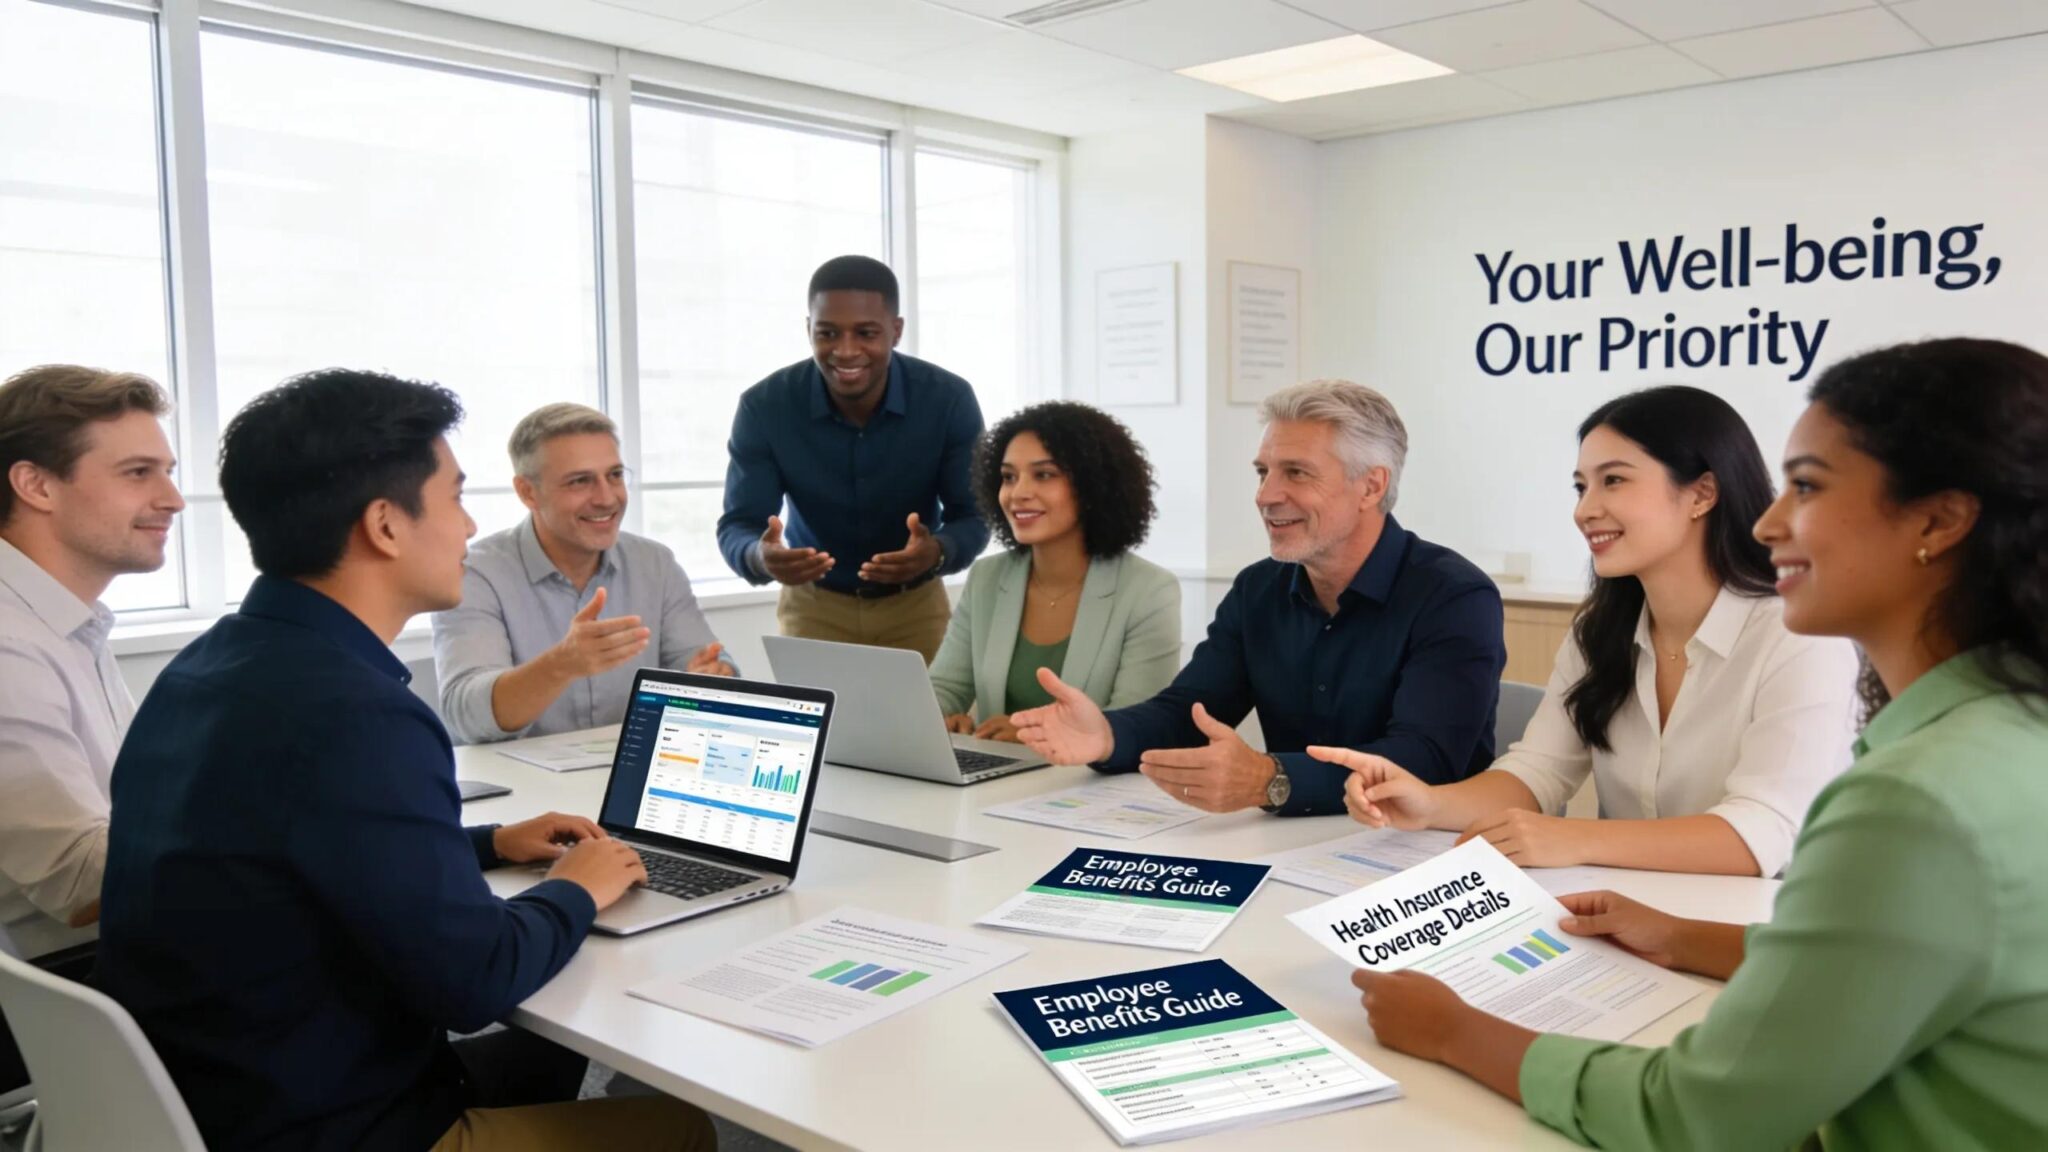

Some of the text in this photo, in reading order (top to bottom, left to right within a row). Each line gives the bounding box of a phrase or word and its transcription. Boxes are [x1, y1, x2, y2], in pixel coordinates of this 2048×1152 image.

[1474, 216, 2002, 305] Your Well-being,
[1475, 307, 1830, 382] Our Priority
[1062, 869, 1231, 898] Benefits Guide
[1083, 854, 1199, 878] Employee
[1330, 871, 1485, 944] Health Insurance
[1358, 890, 1510, 966] Coverage Details
[1033, 980, 1172, 1016] Employee
[1046, 989, 1244, 1038] Benefits Guide
